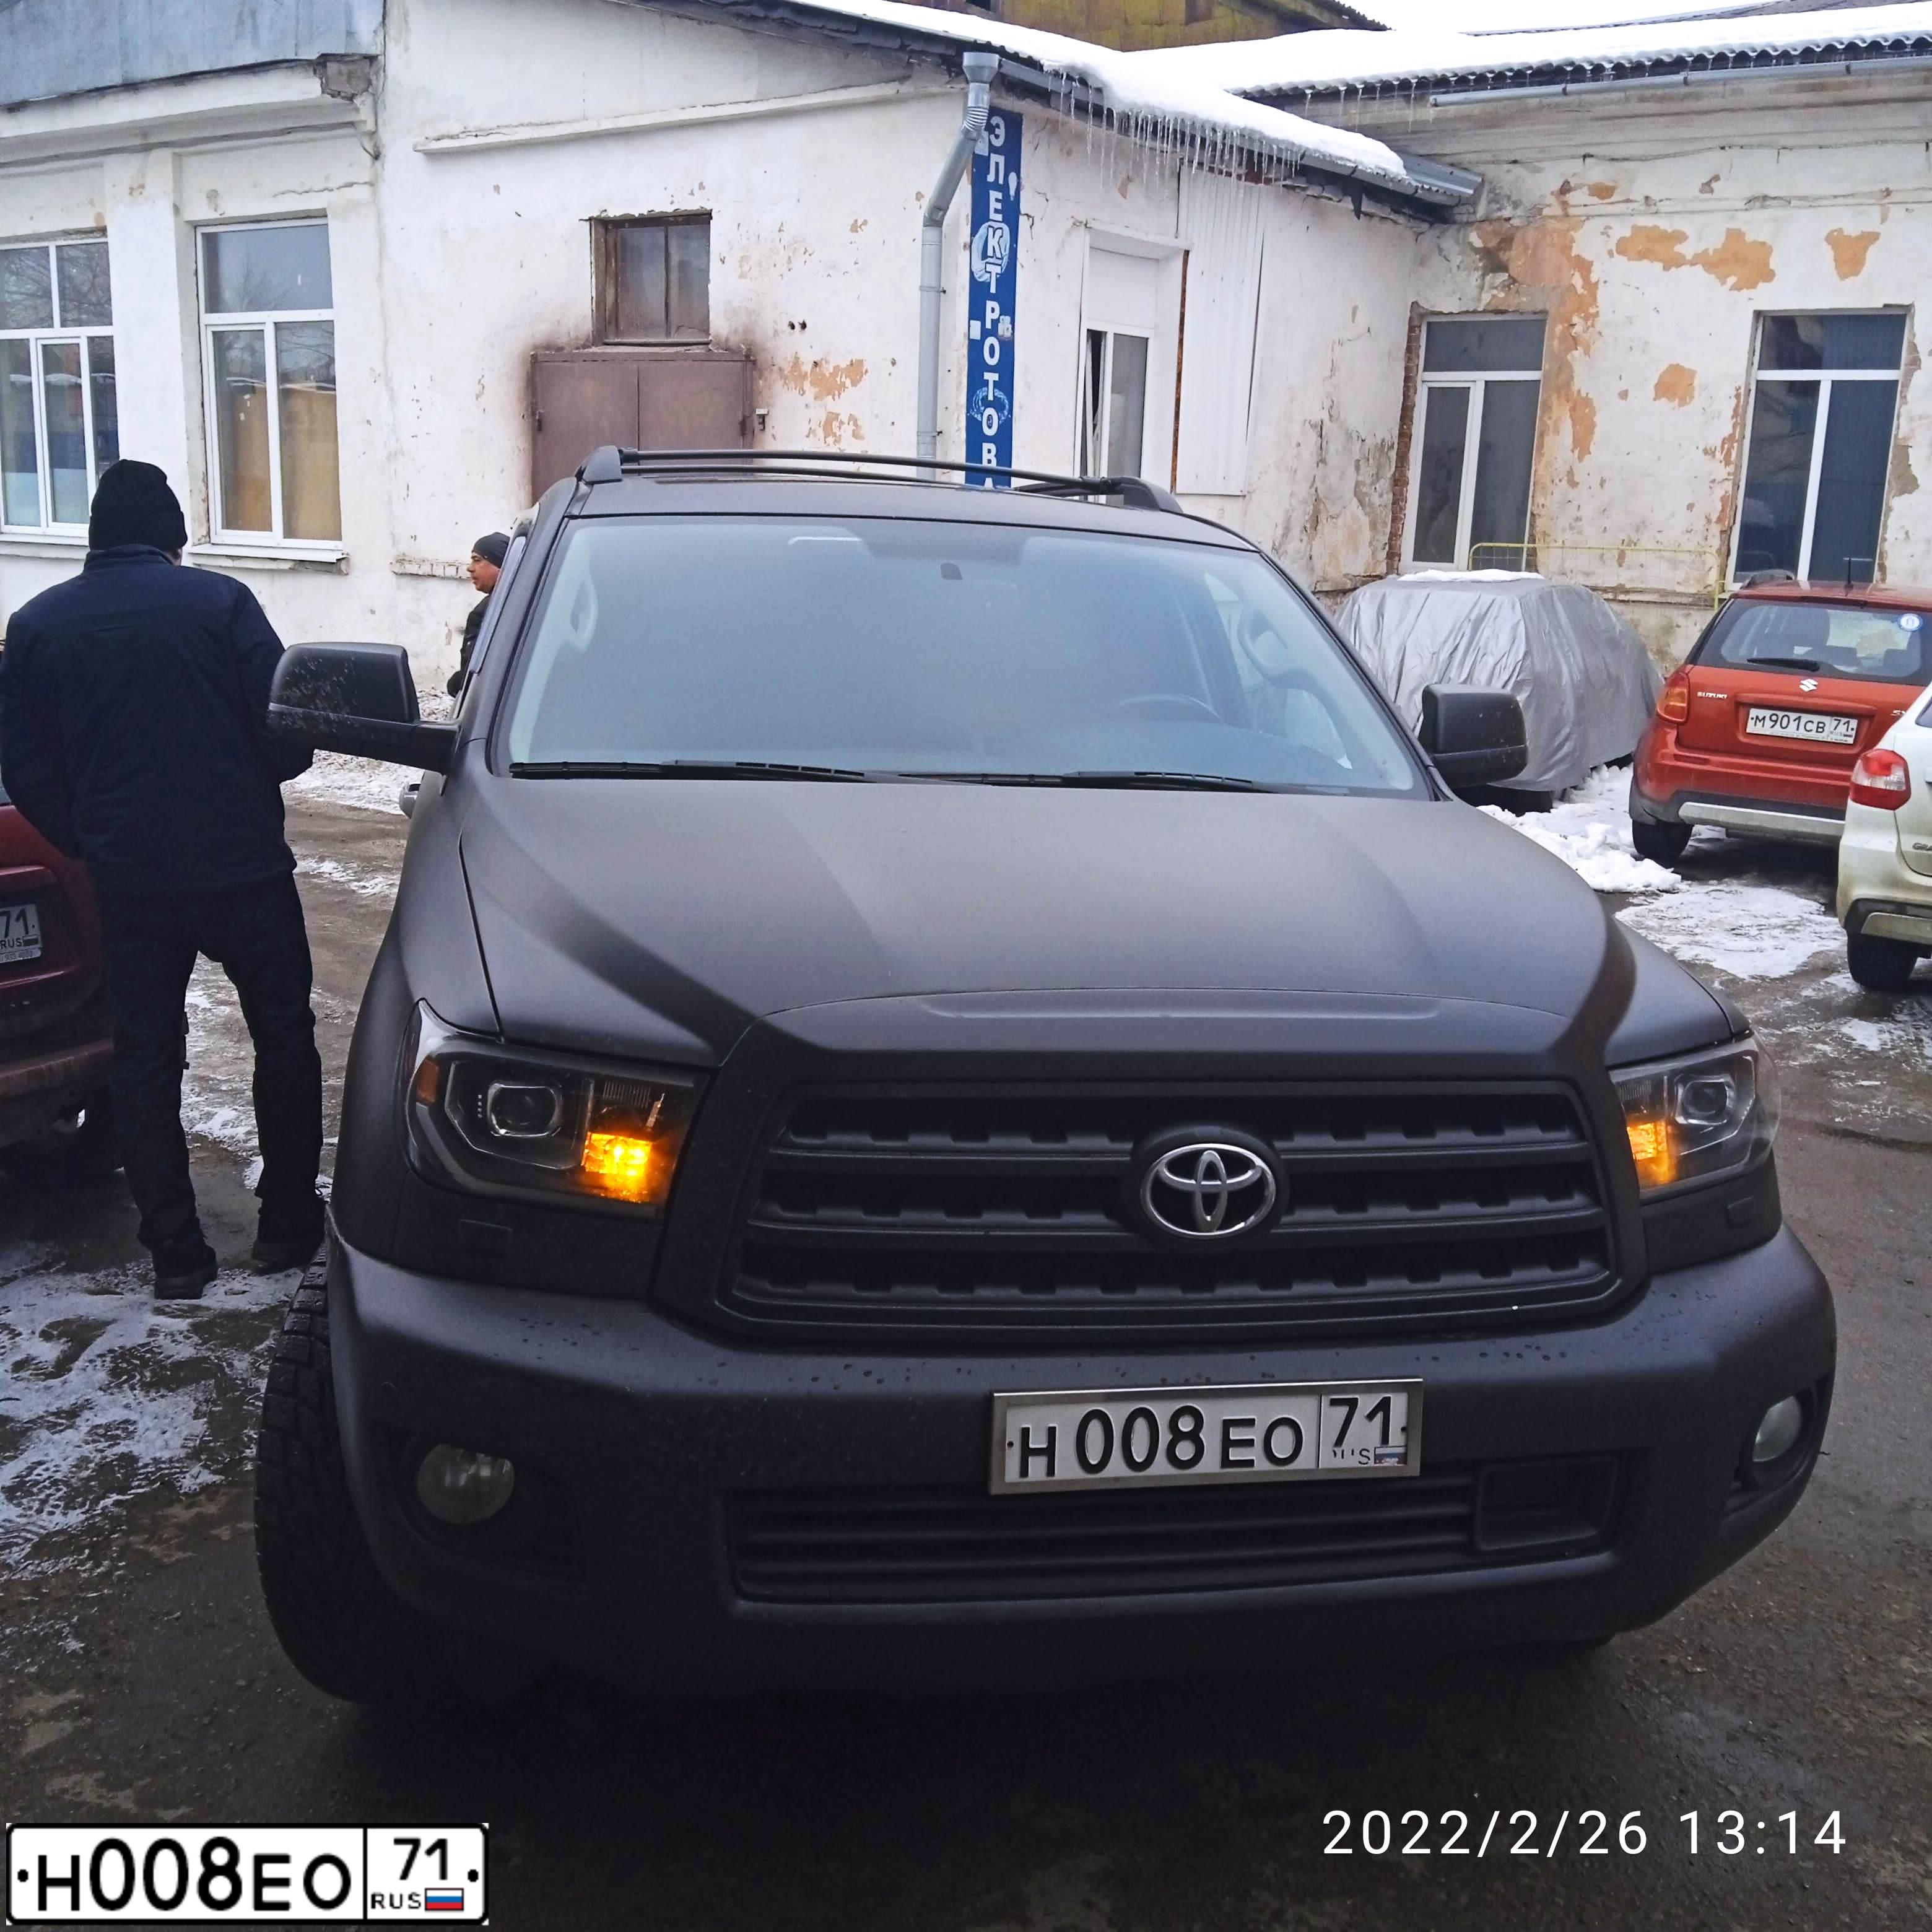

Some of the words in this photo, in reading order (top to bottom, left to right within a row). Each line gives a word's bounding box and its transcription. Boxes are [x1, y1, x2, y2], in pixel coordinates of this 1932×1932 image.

[1834, 718, 1850, 732] 71
[0, 938, 22, 949] RUS
[1020, 1404, 1303, 1478] Н008ЕО
[1329, 1396, 1391, 1447] 71
